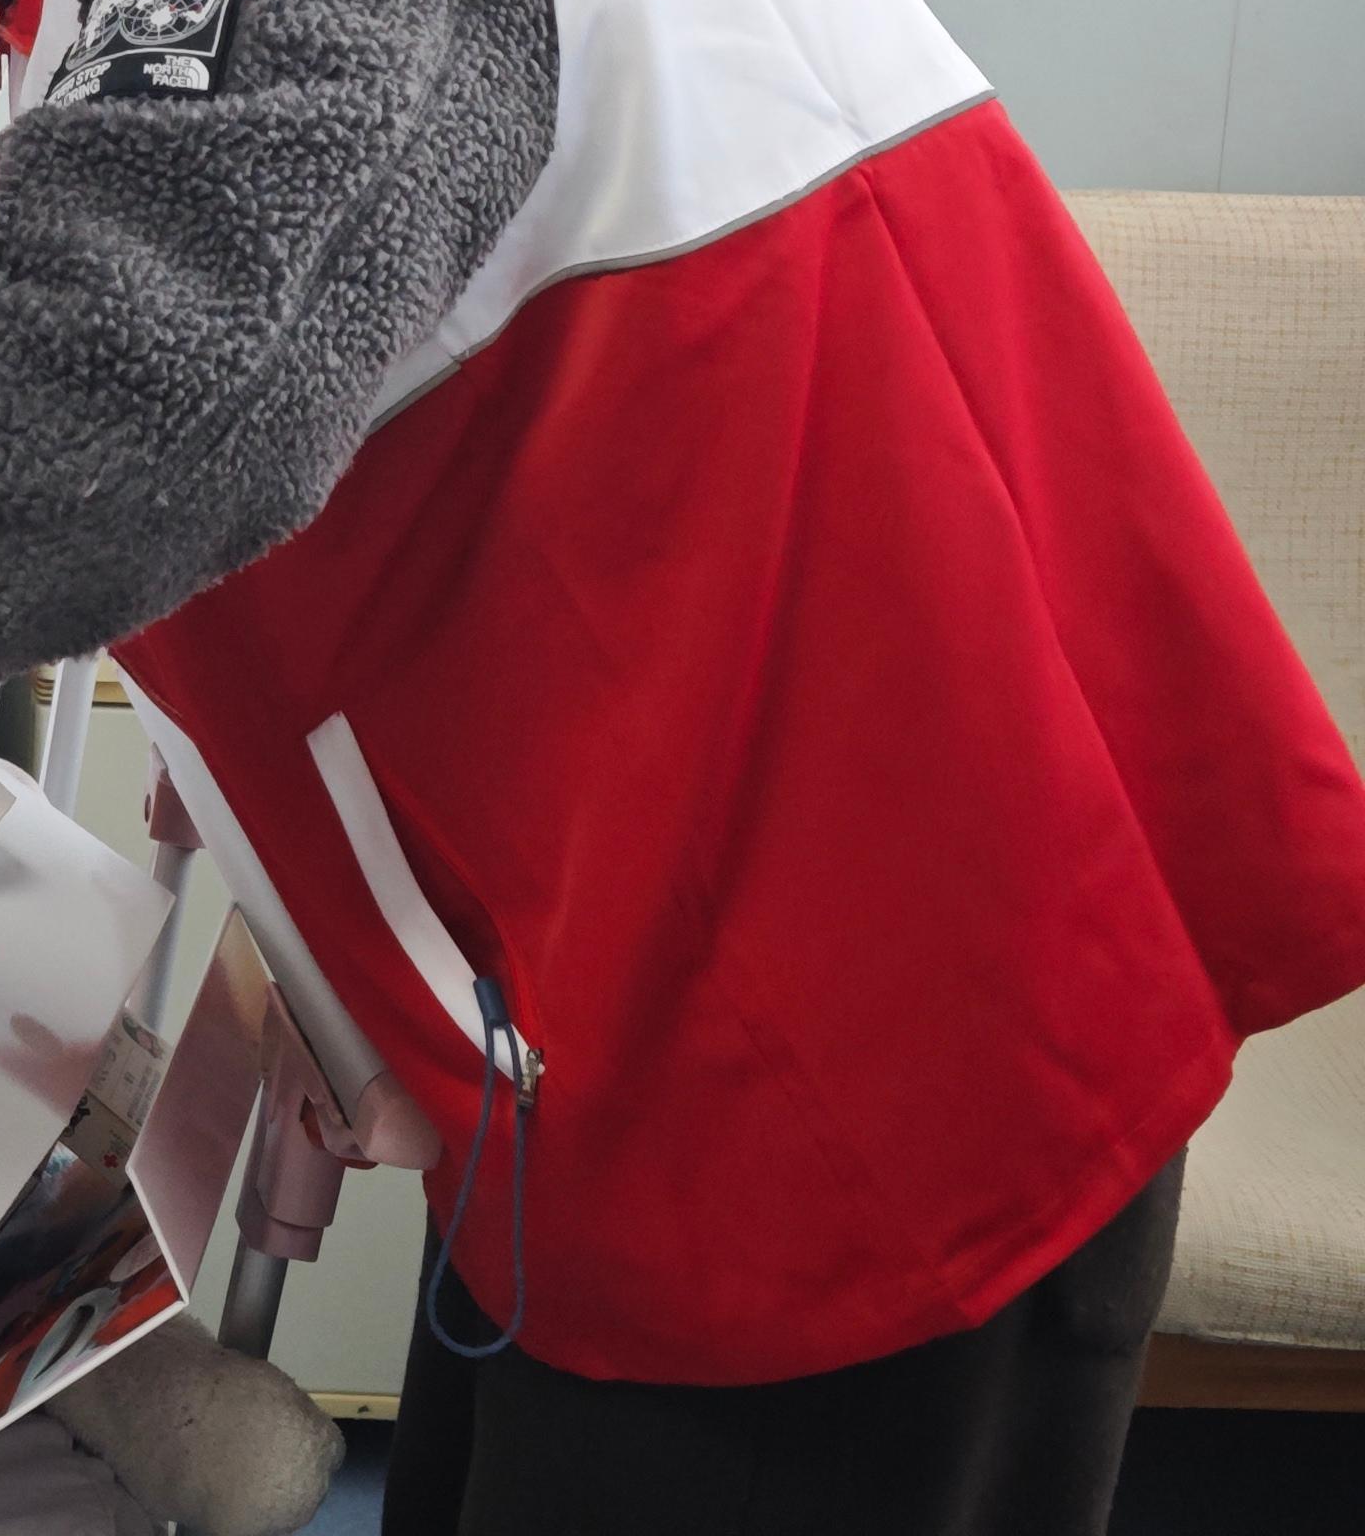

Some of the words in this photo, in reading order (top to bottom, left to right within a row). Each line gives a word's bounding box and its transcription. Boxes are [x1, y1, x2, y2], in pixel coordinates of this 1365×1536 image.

[165, 56, 191, 67] THE
[75, 61, 111, 86] STOP
[143, 63, 190, 76] NORTH
[152, 74, 188, 87] FACE
